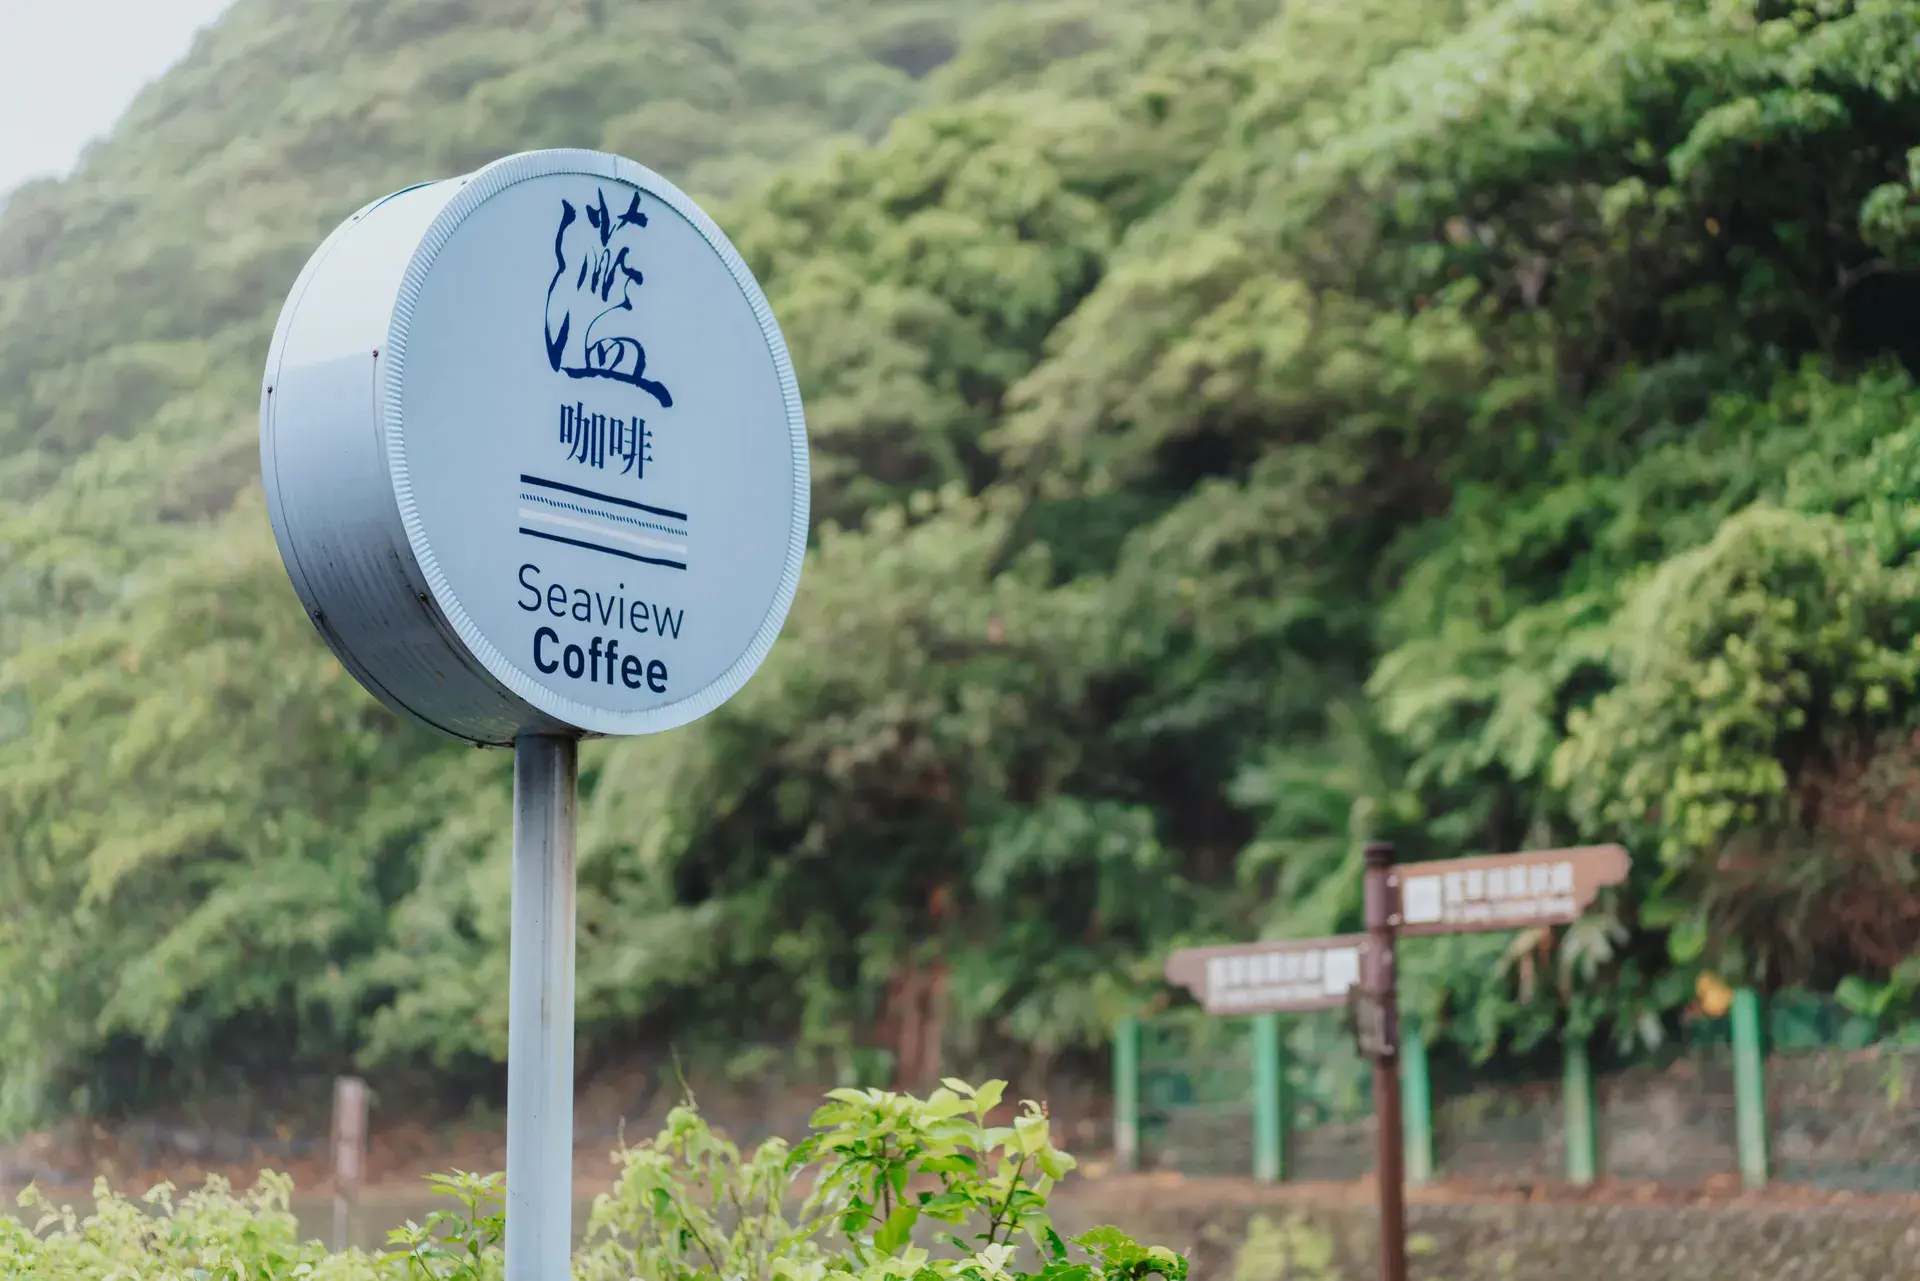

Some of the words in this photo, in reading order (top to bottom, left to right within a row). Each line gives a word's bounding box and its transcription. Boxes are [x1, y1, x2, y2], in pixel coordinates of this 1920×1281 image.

[559, 401, 654, 480] 咖啡
[517, 563, 684, 639] Seaview
[533, 626, 668, 693] Coffee
